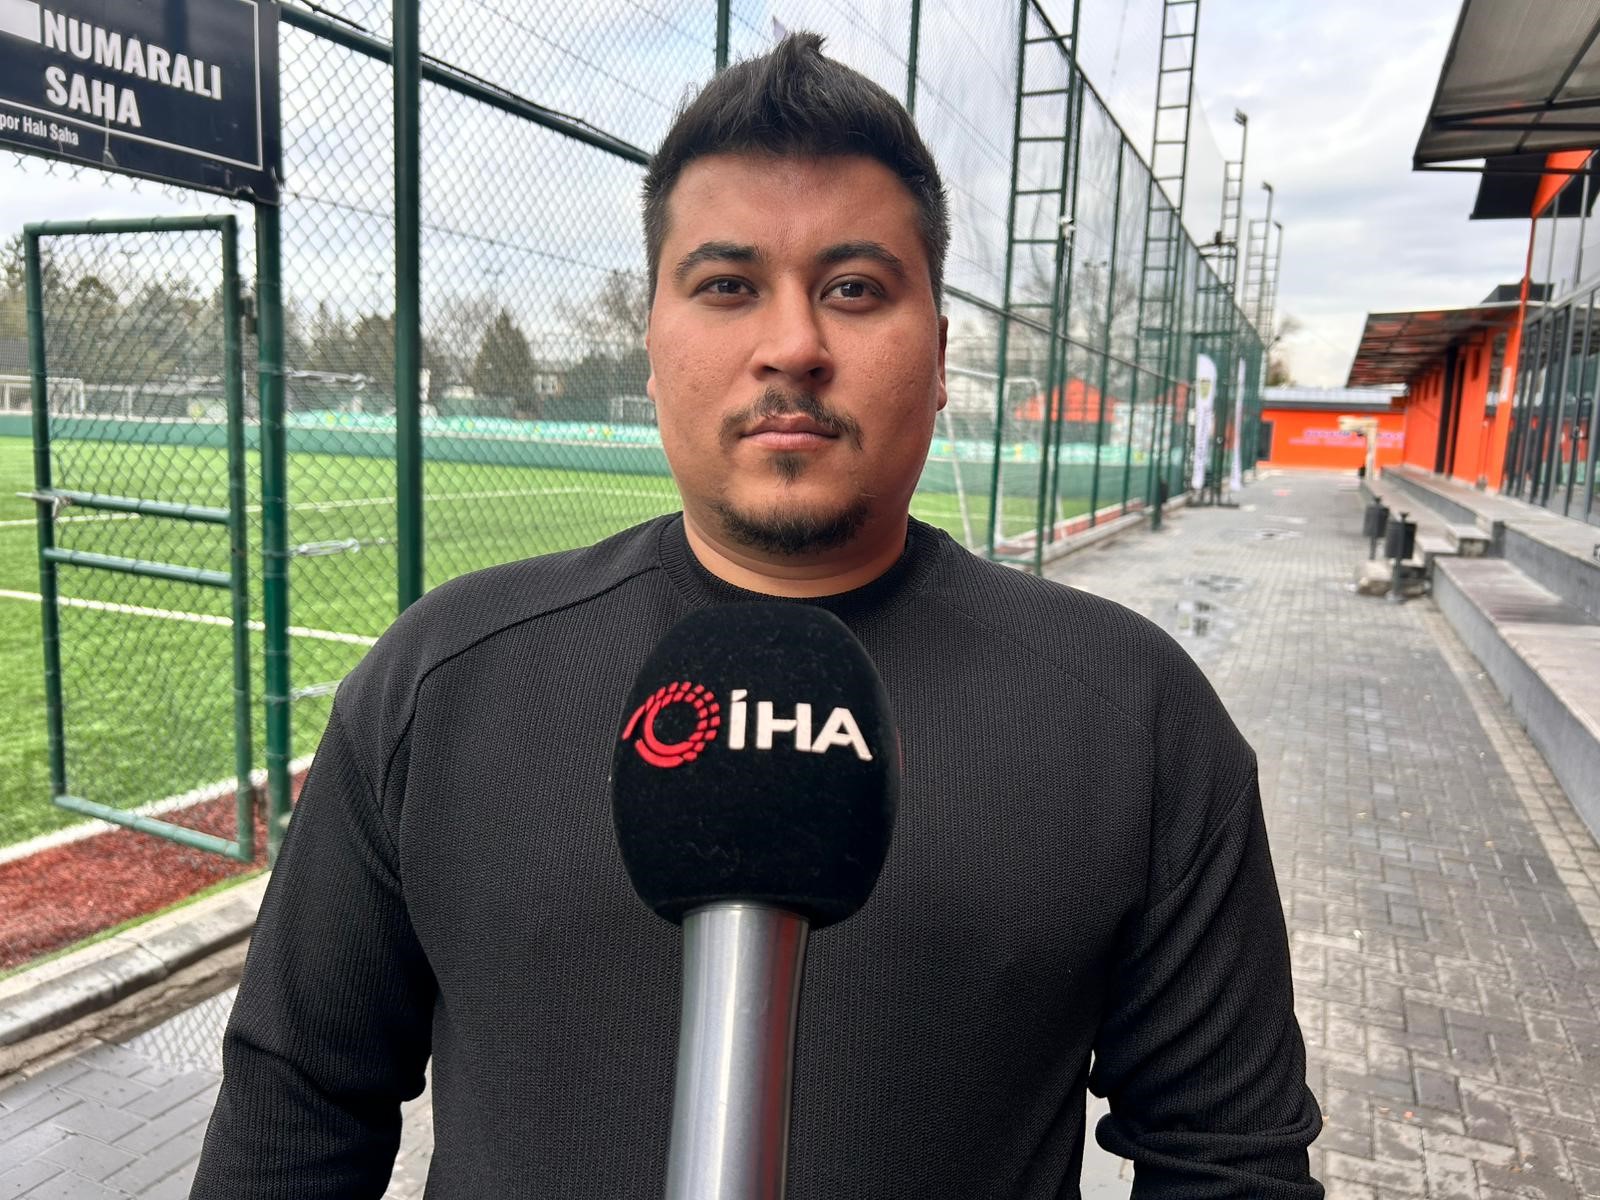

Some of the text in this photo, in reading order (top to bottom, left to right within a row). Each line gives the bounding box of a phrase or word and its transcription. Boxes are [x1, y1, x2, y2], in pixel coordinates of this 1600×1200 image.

[44, 9, 222, 100] NUMARALI
[45, 66, 142, 127] SAHA
[49, 122, 79, 146] Saha
